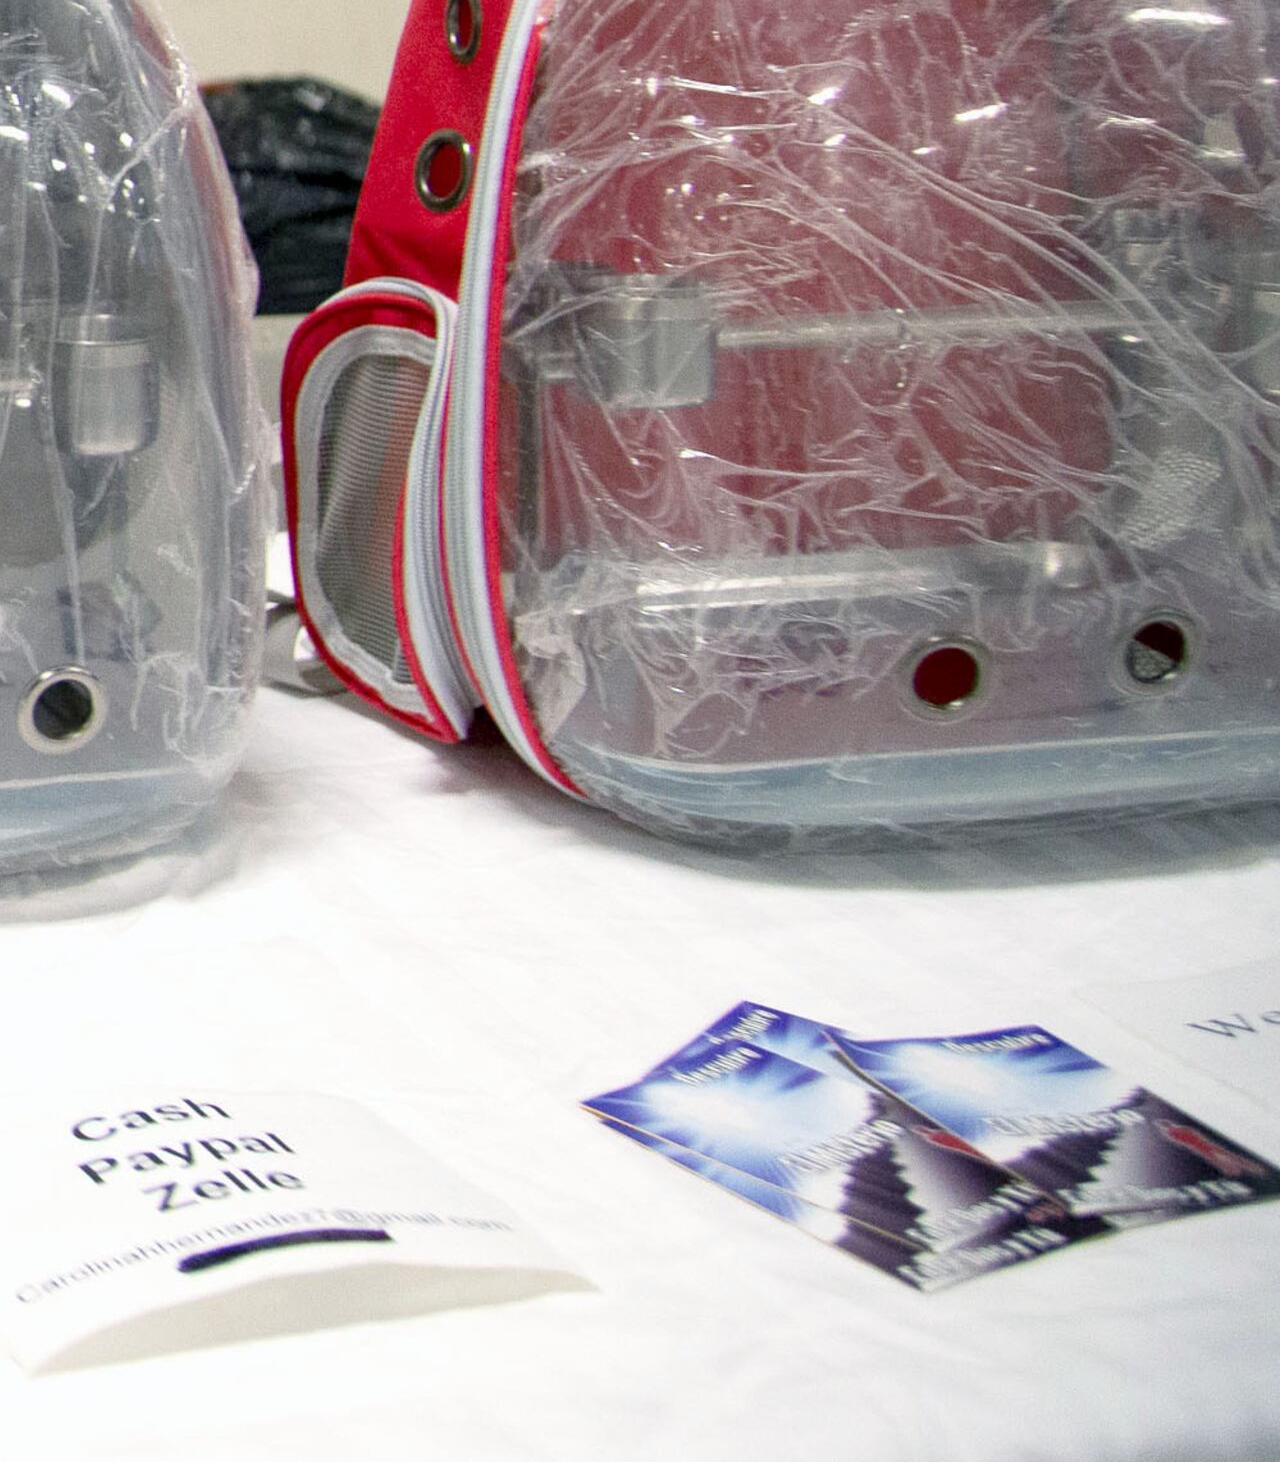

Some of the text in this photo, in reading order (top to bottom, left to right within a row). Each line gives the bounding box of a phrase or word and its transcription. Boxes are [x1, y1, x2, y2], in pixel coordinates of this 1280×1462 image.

[71, 1096, 233, 1144] Cash
[77, 1130, 297, 1187] Paypal
[142, 1167, 306, 1213] Zelle
